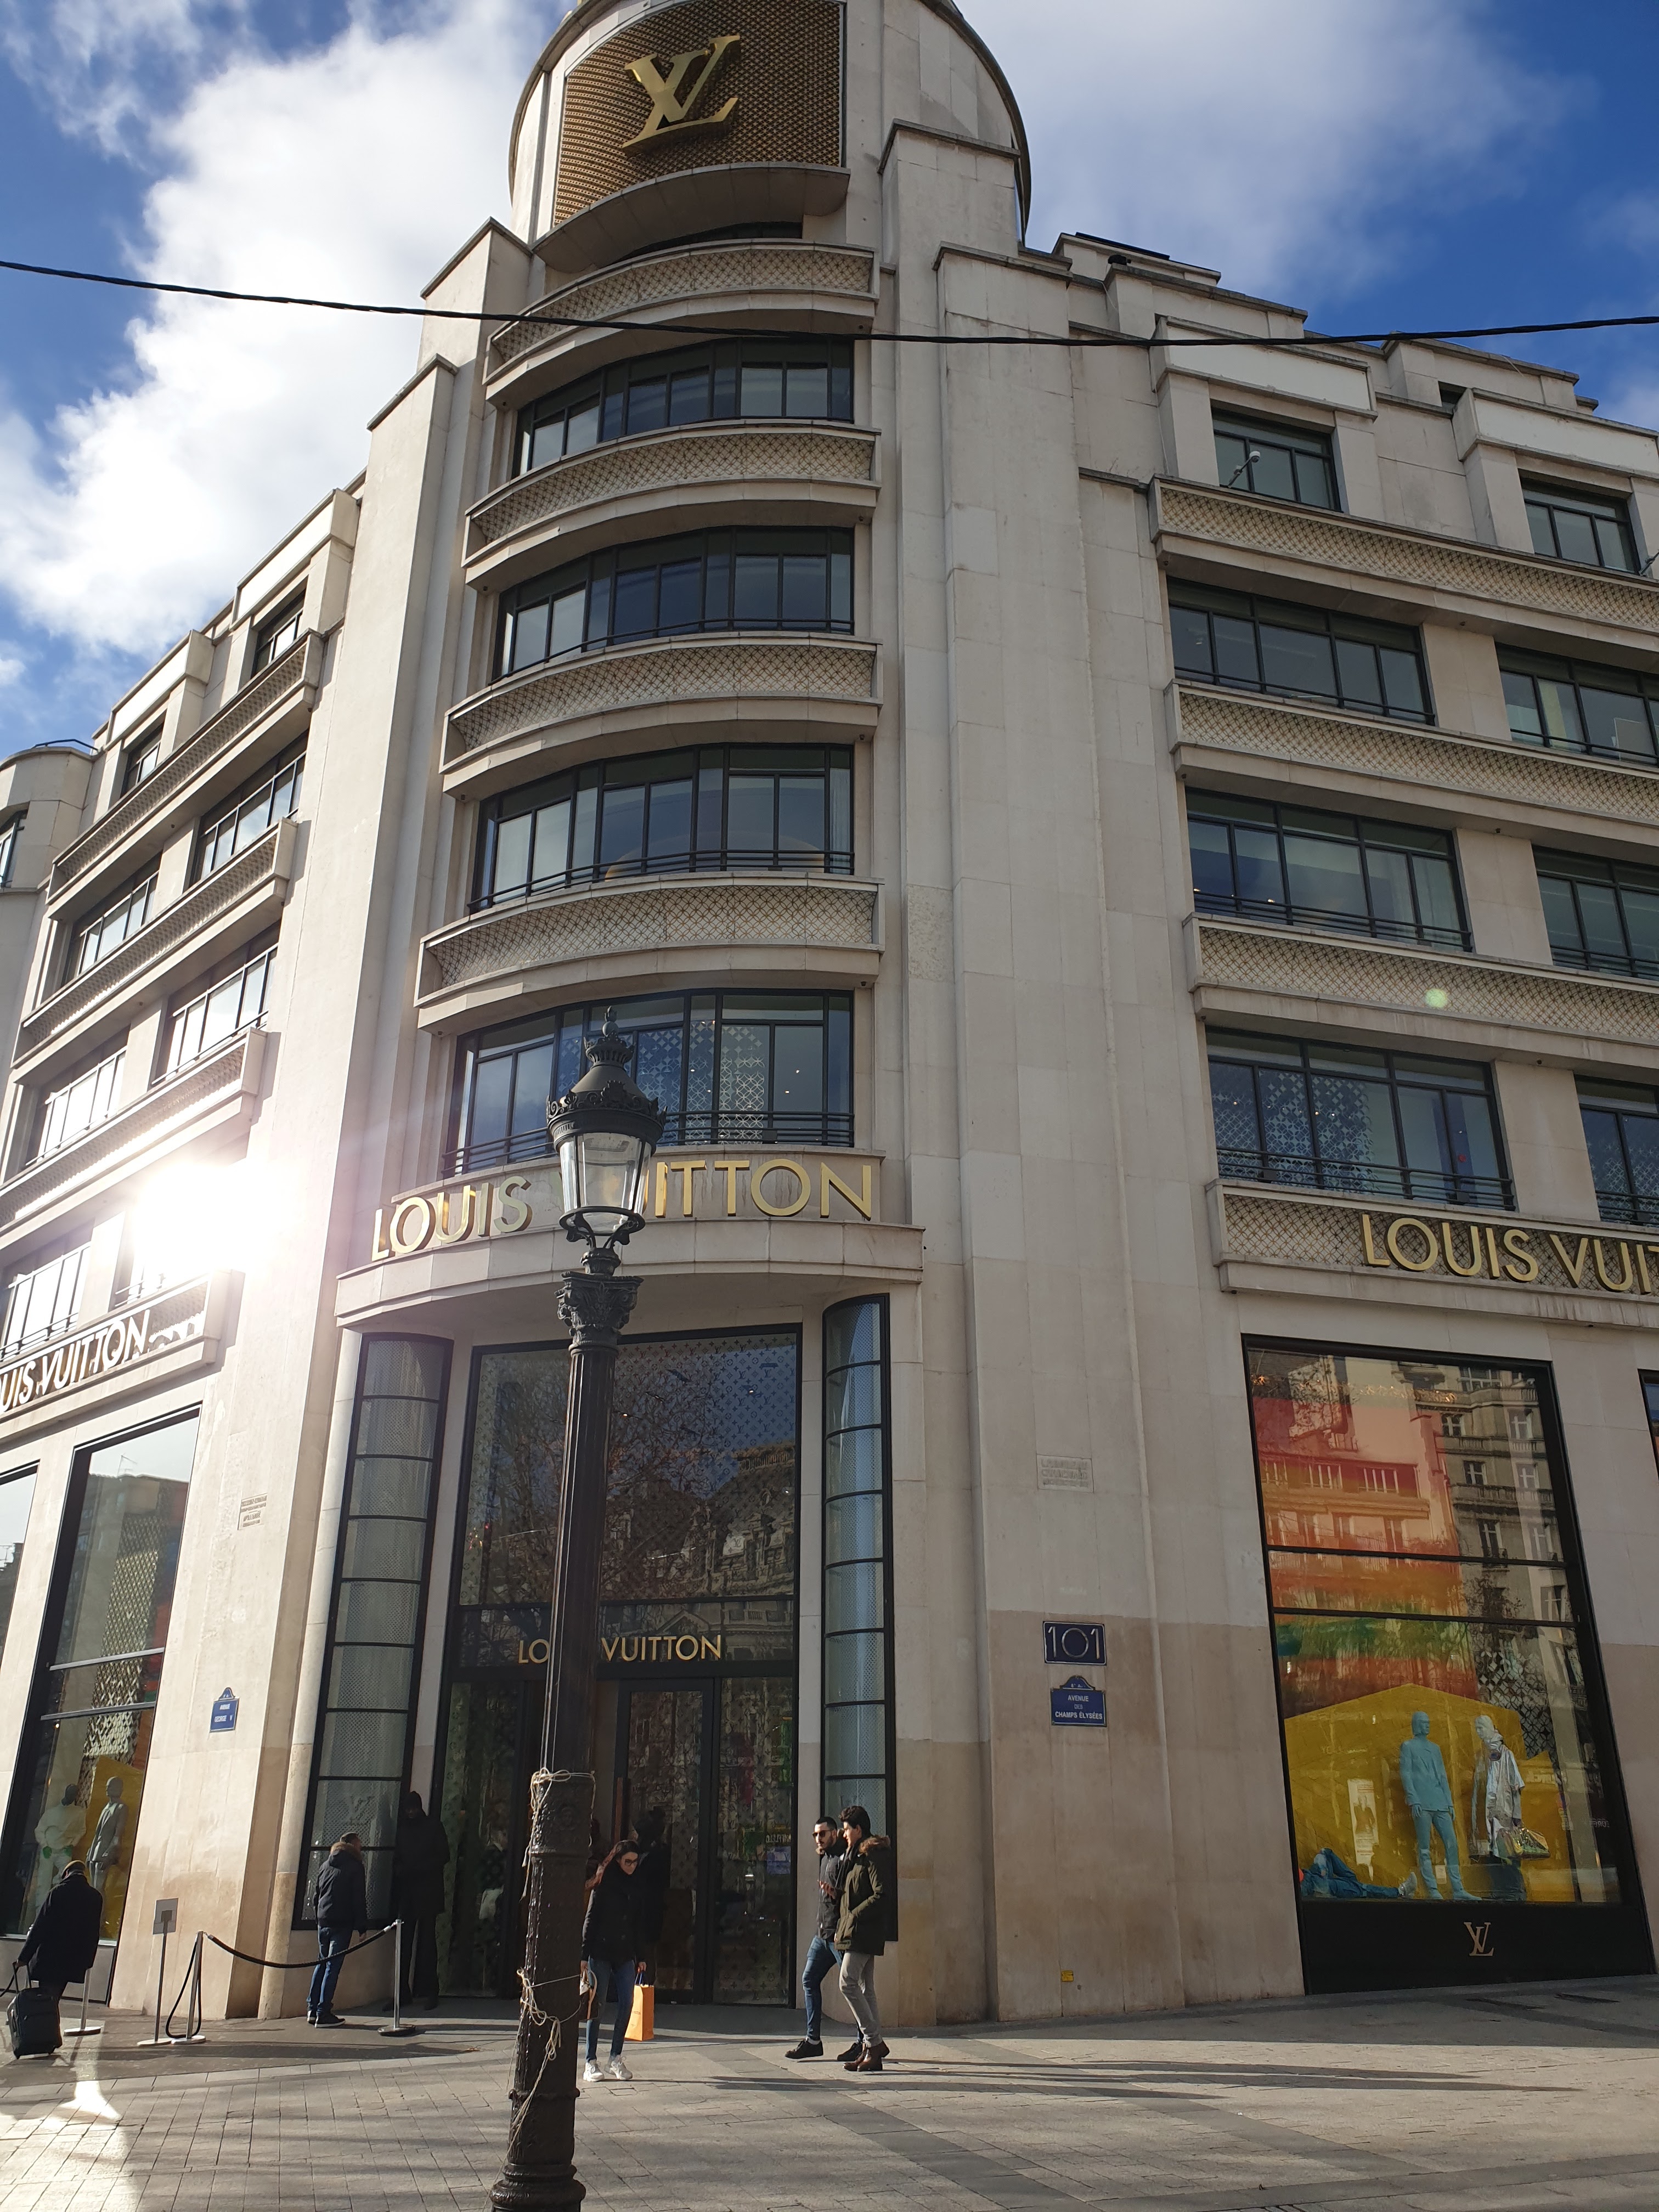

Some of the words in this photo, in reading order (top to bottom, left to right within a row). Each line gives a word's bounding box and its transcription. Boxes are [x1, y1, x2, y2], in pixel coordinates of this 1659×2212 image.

[371, 1175, 532, 1262] LOUIS
[551, 1158, 871, 1221] ITTON
[1361, 1214, 1539, 1283] LOUIS
[0, 1361, 36, 1413] UIS
[42, 1309, 150, 1395] VUITTON
[601, 1634, 721, 1662] VUITTON
[1048, 1626, 1100, 1660] 101
[1079, 1711, 1103, 1720] ÉLYSÉES
